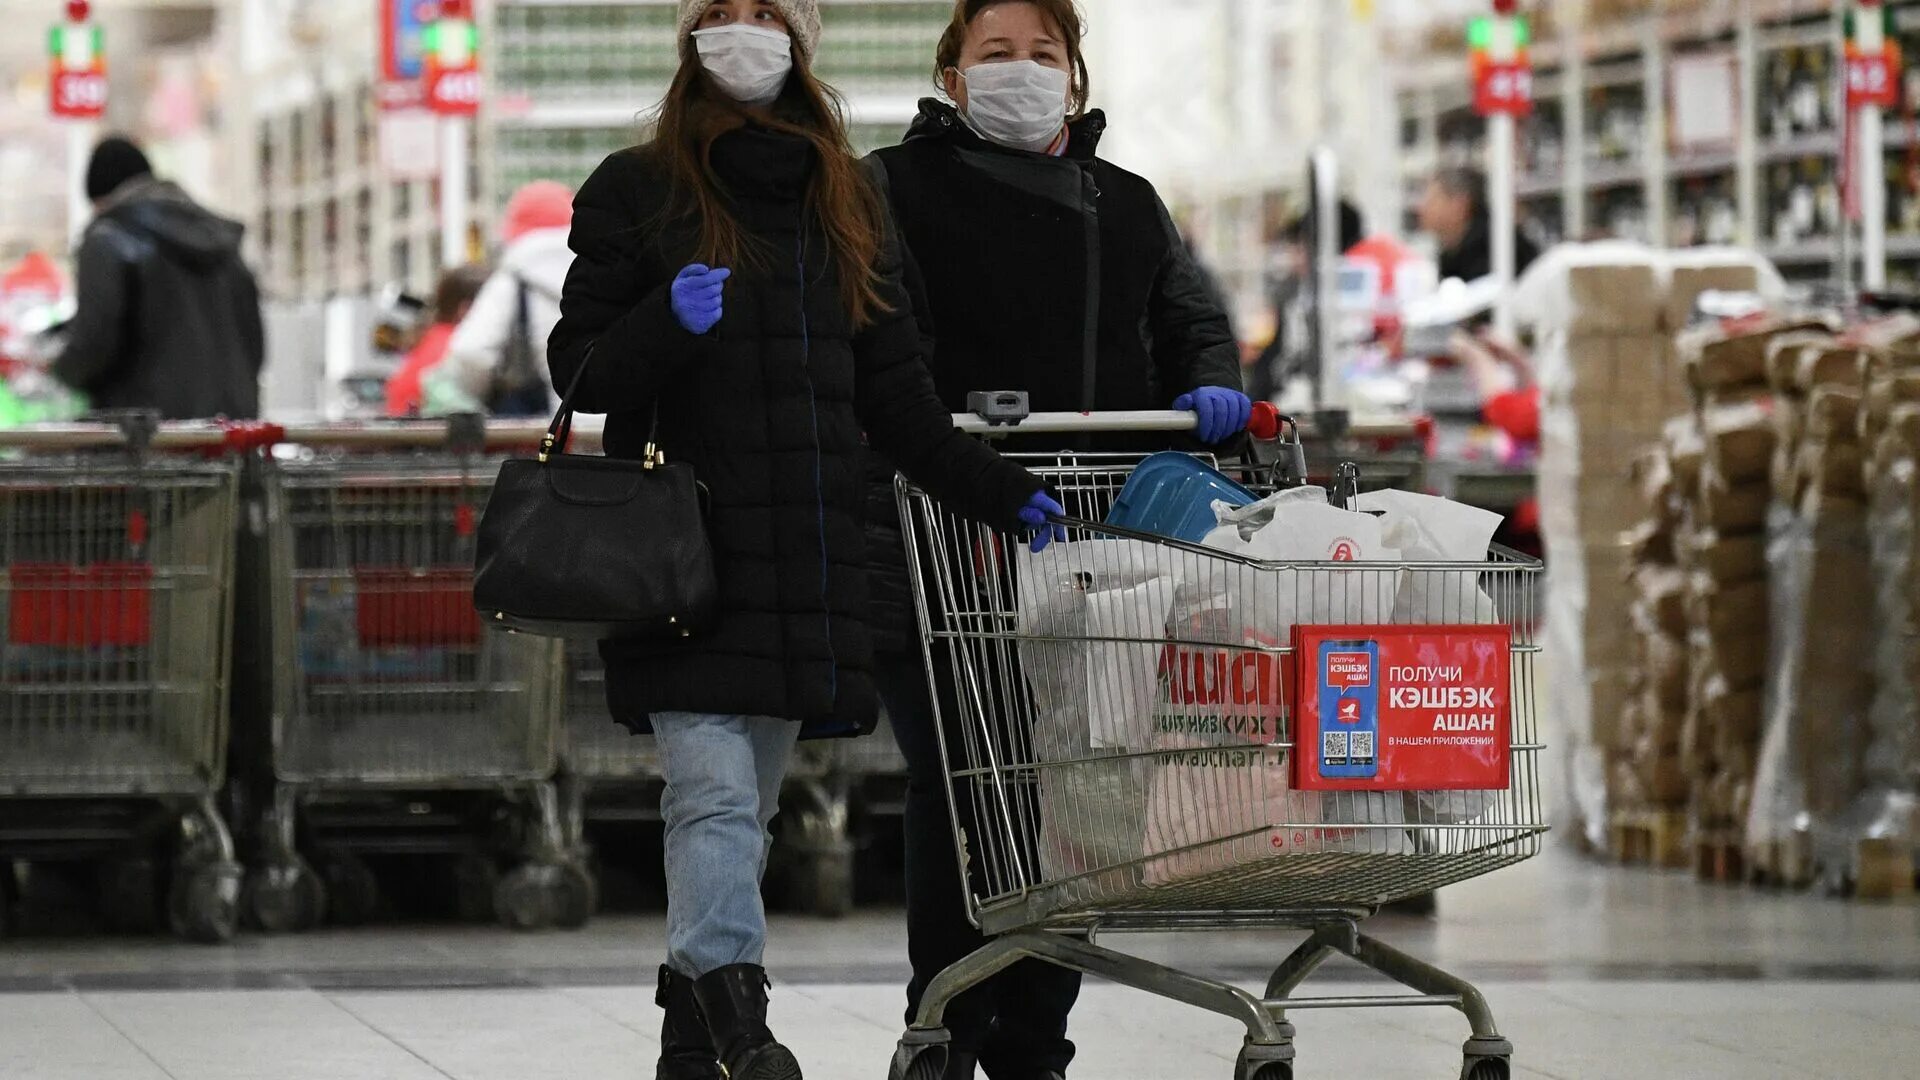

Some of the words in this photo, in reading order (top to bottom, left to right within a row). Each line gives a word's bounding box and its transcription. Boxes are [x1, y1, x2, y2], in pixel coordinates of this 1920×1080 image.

[1330, 664, 1368, 672] КЭШБЭК
[1346, 673, 1368, 681] АШАН
[1389, 667, 1462, 682] ПОЛУЧИ
[1389, 687, 1495, 709] КЭШБЭК
[1433, 714, 1495, 731] АШАН
[1388, 737, 1395, 745] В
[1397, 736, 1431, 746] НАШЕМ
[1433, 736, 1494, 746] ПРИЛОЖЕНИИ
